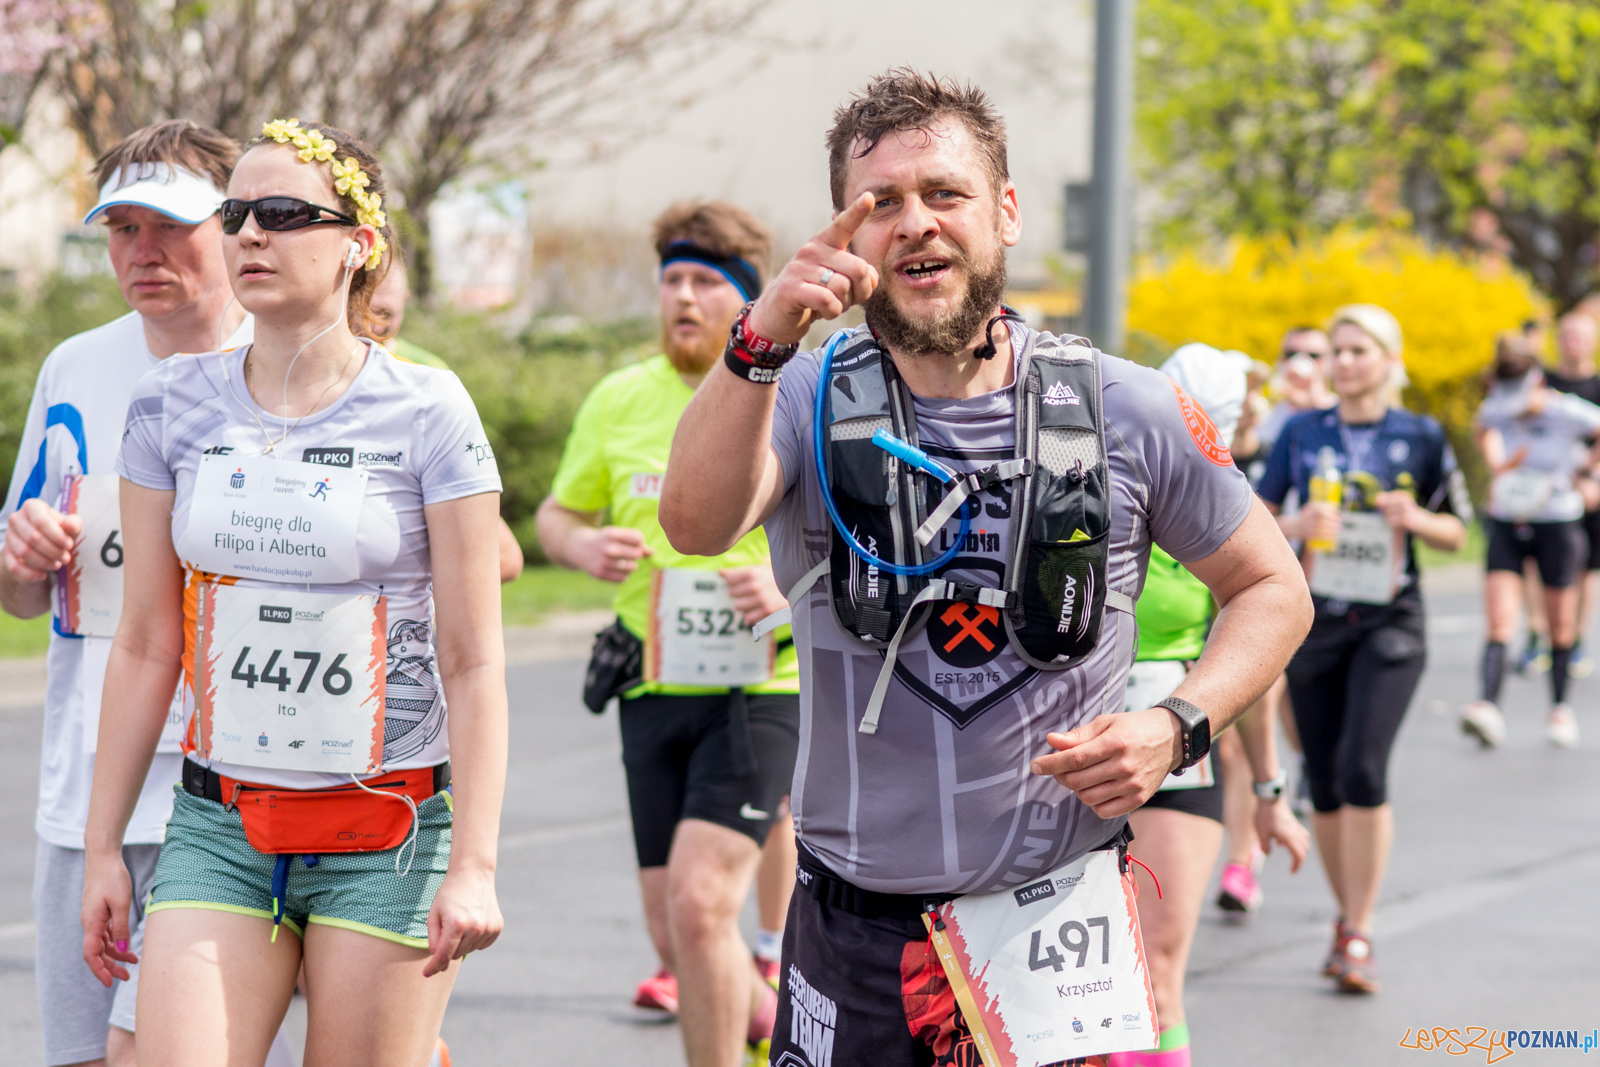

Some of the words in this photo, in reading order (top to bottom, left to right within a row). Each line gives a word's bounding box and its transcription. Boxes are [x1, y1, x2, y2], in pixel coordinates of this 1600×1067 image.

[842, 356, 858, 367] WIND
[858, 348, 882, 362] TRACKER
[273, 486, 295, 494] razem
[275, 476, 307, 488] Biegajmy
[231, 510, 284, 535] biegnę
[288, 515, 312, 533] dla
[214, 532, 254, 554] Filipa
[260, 537, 264, 552] i
[268, 538, 327, 558] Alberta
[233, 563, 313, 578] www.fundacjapkobp.pl
[1056, 574, 1078, 634] AONIJIE
[231, 645, 353, 696] 4476
[934, 672, 963, 685] EST.
[968, 671, 1001, 684] 2015
[277, 703, 297, 716] Ita
[1027, 916, 1110, 973] 497
[1056, 976, 1114, 999] Krzysztof
[790, 994, 836, 1067] TEAM
